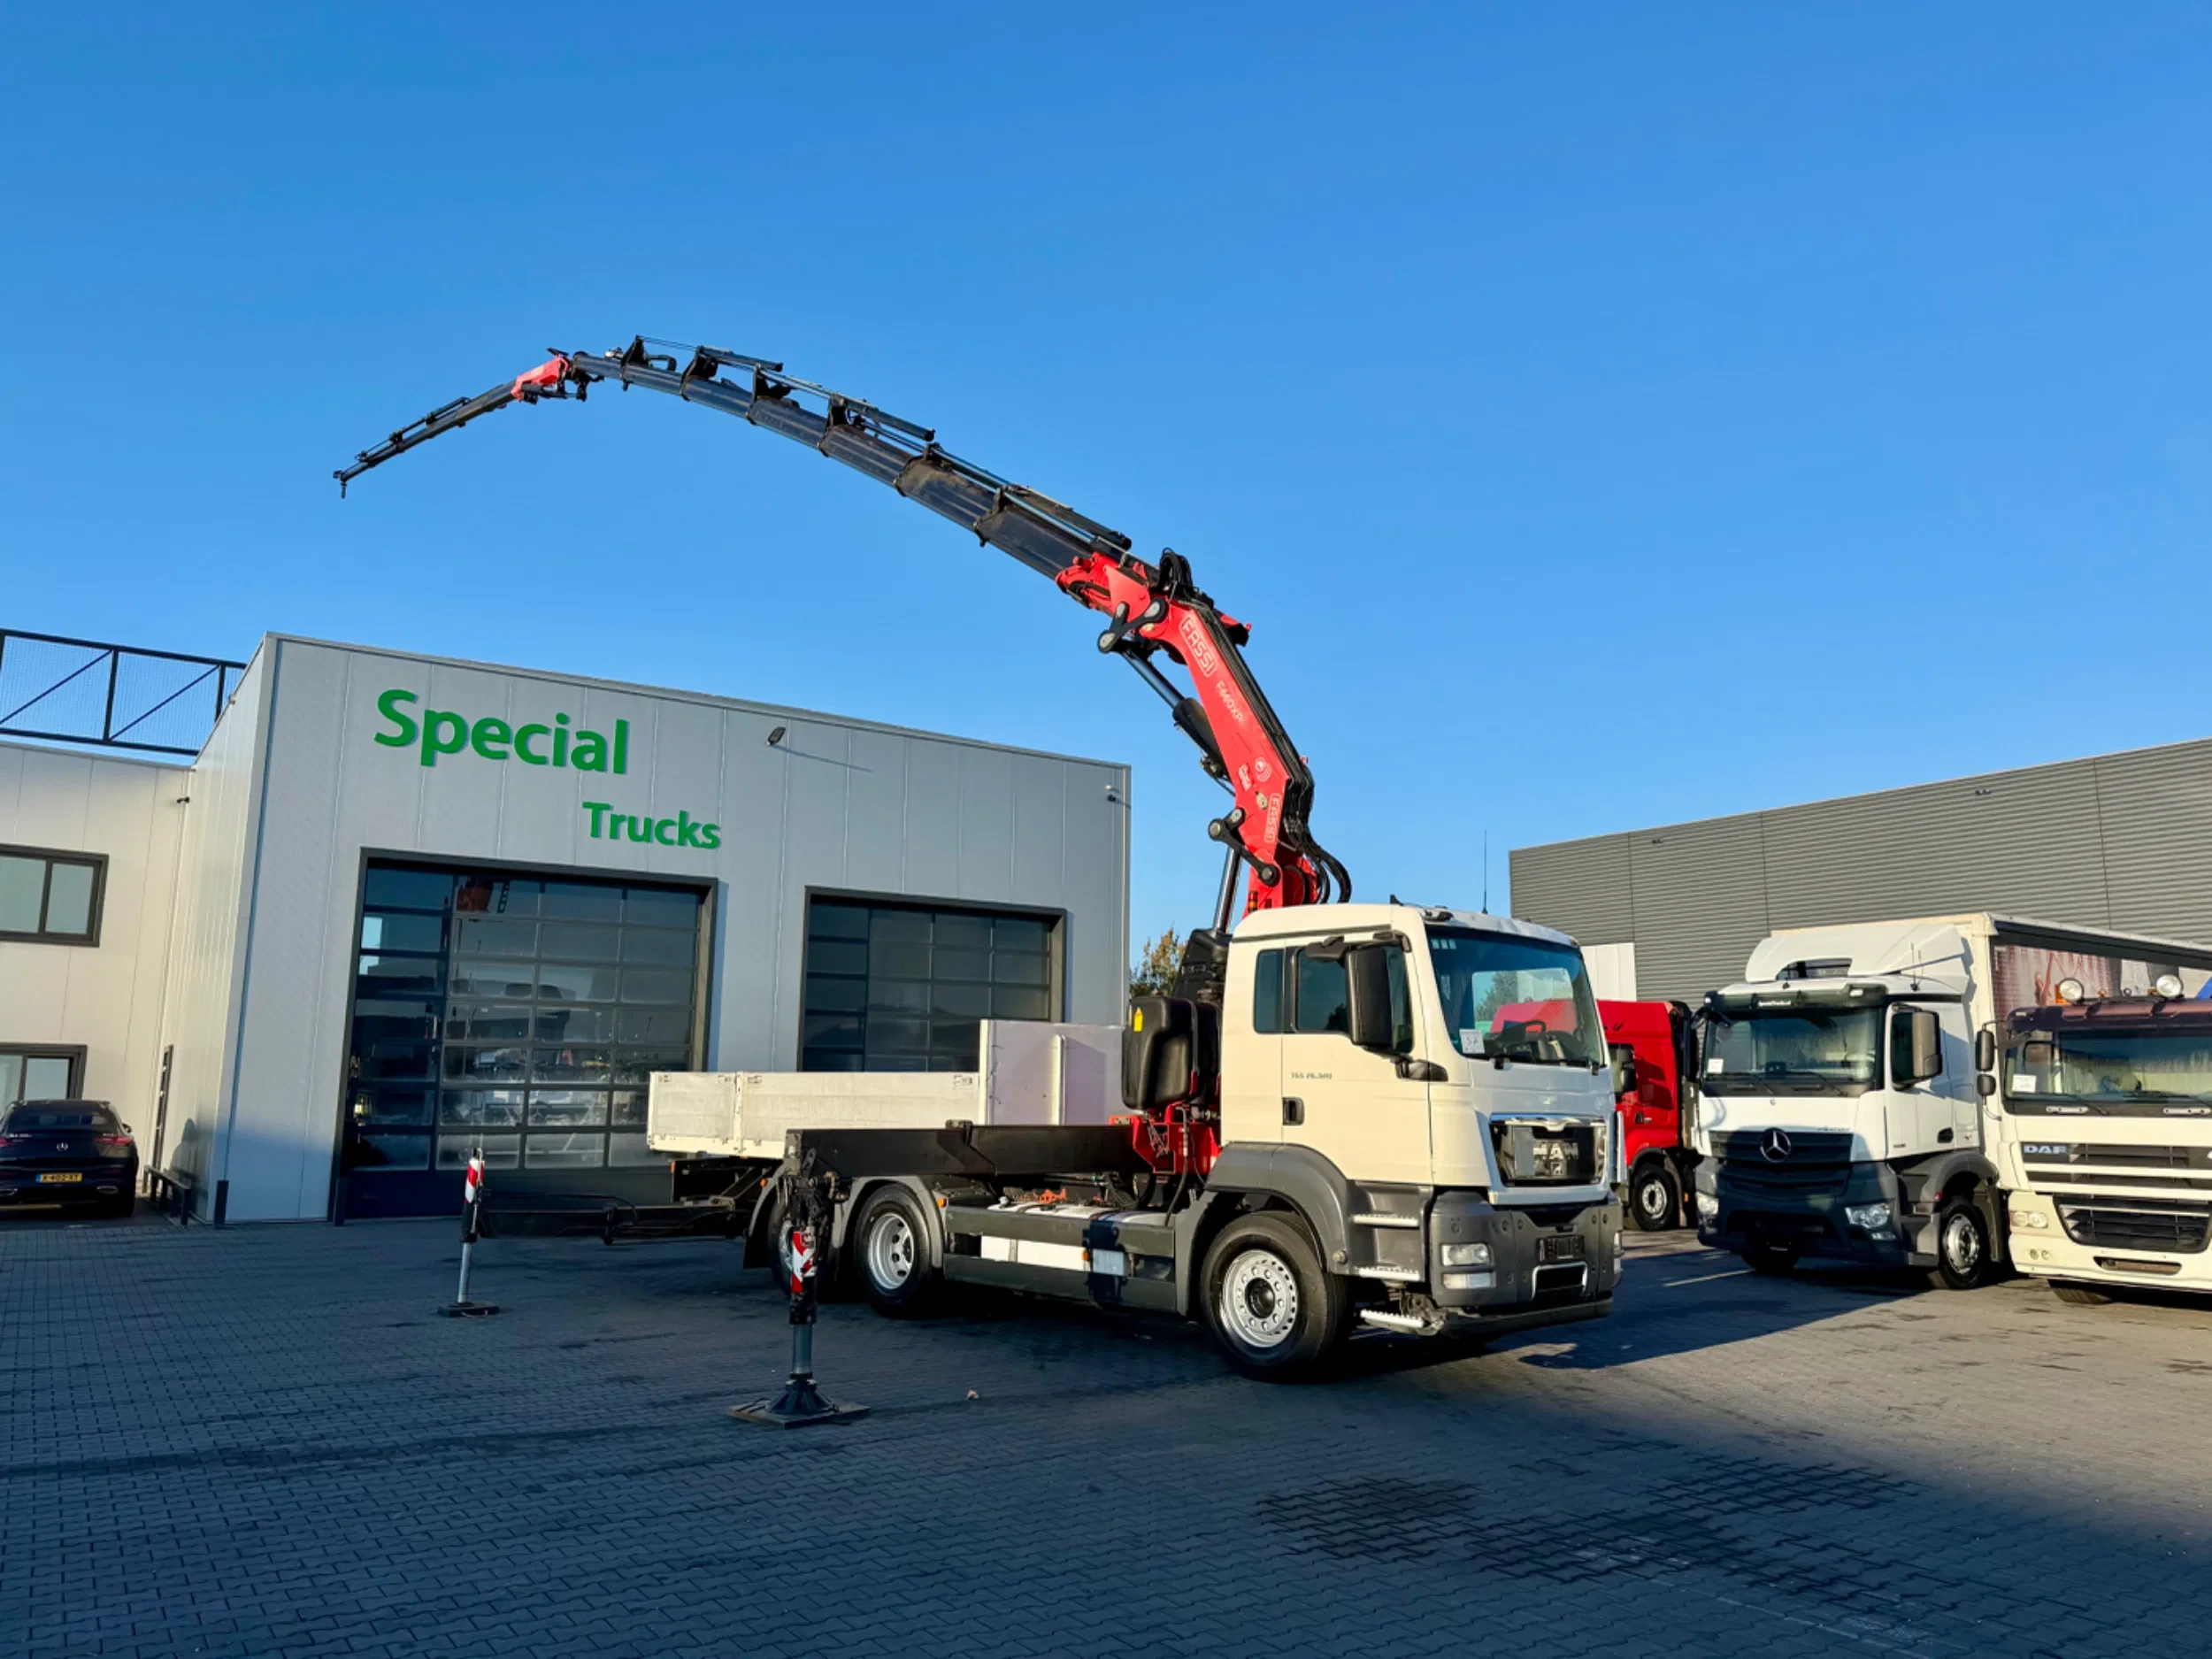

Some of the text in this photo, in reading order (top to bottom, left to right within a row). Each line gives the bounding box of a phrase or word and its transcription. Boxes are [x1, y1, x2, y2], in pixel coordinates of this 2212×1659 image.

[1182, 616, 1216, 672] FASSI
[373, 689, 629, 774] Special
[582, 802, 720, 849] Trucks
[2024, 1145, 2067, 1155] DAF
